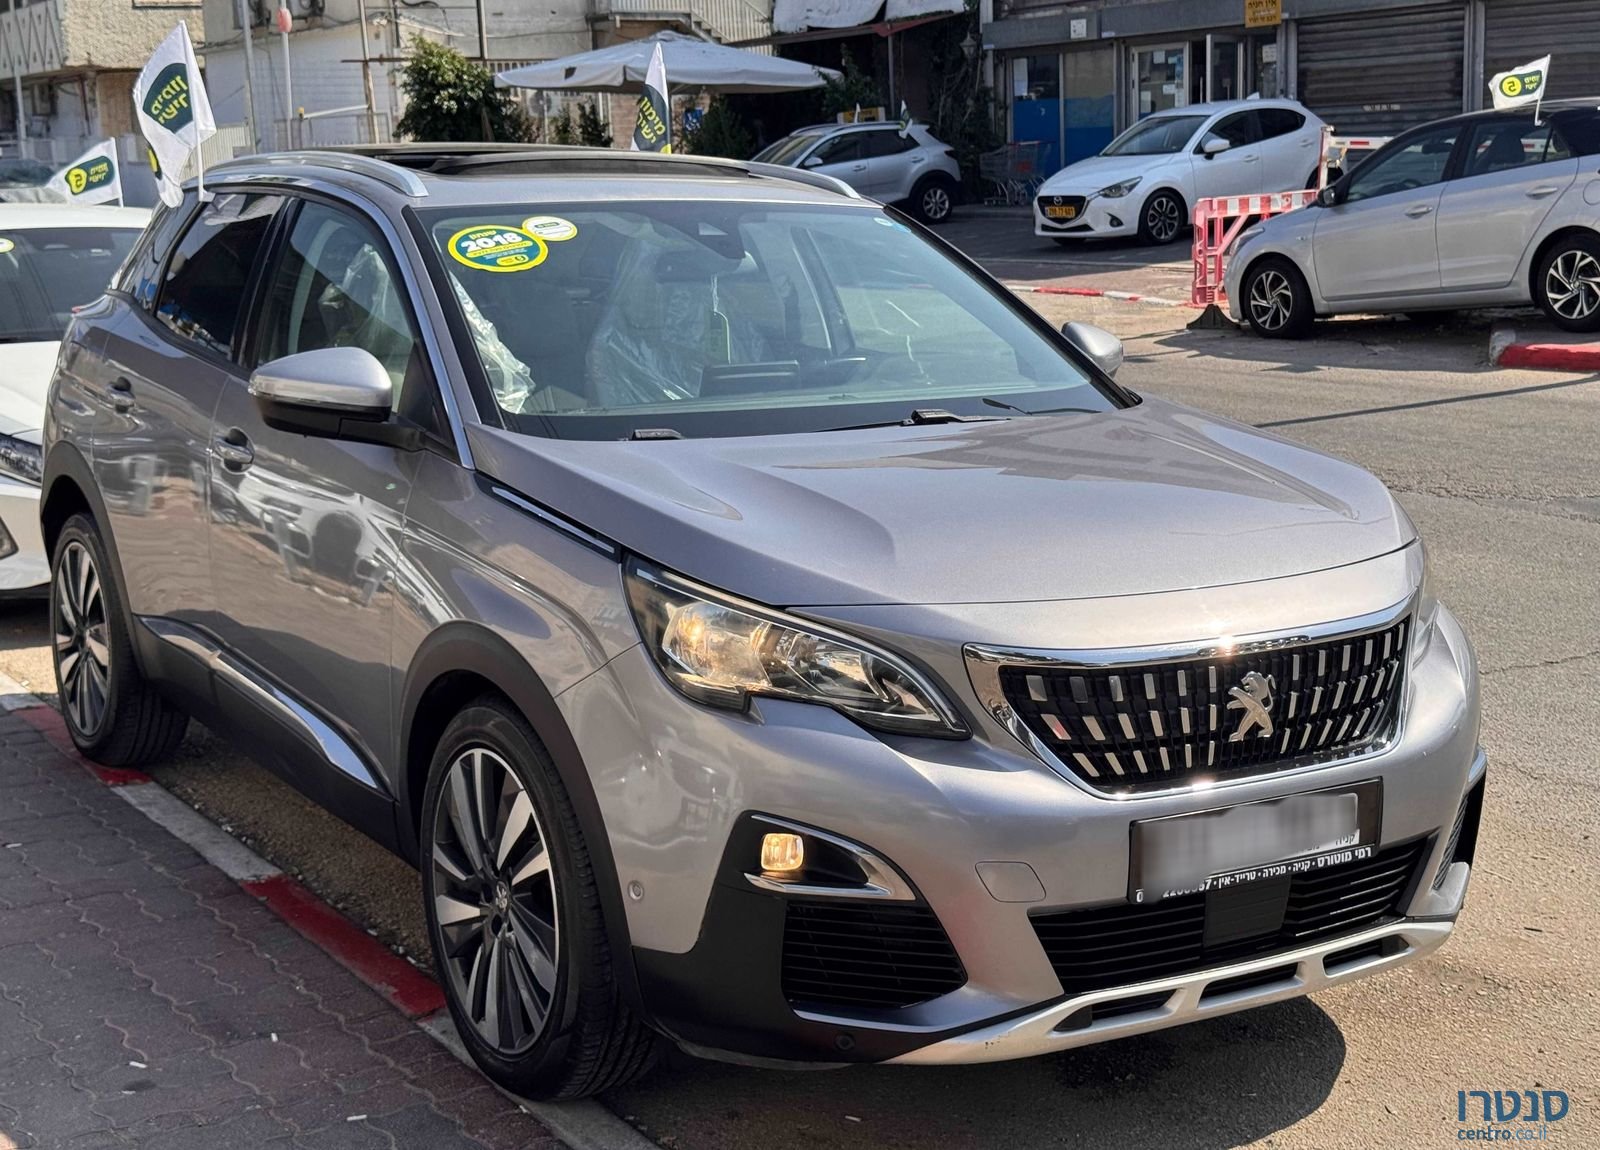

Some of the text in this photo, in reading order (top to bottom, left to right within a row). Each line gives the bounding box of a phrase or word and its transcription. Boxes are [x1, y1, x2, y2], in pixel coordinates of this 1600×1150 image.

[637, 112, 657, 143] ישיר
[640, 96, 666, 136] מימון
[460, 232, 523, 253] 2018
[1217, 846, 1372, 890] רמי מוטורס קניה מכירה טרייד-אין
